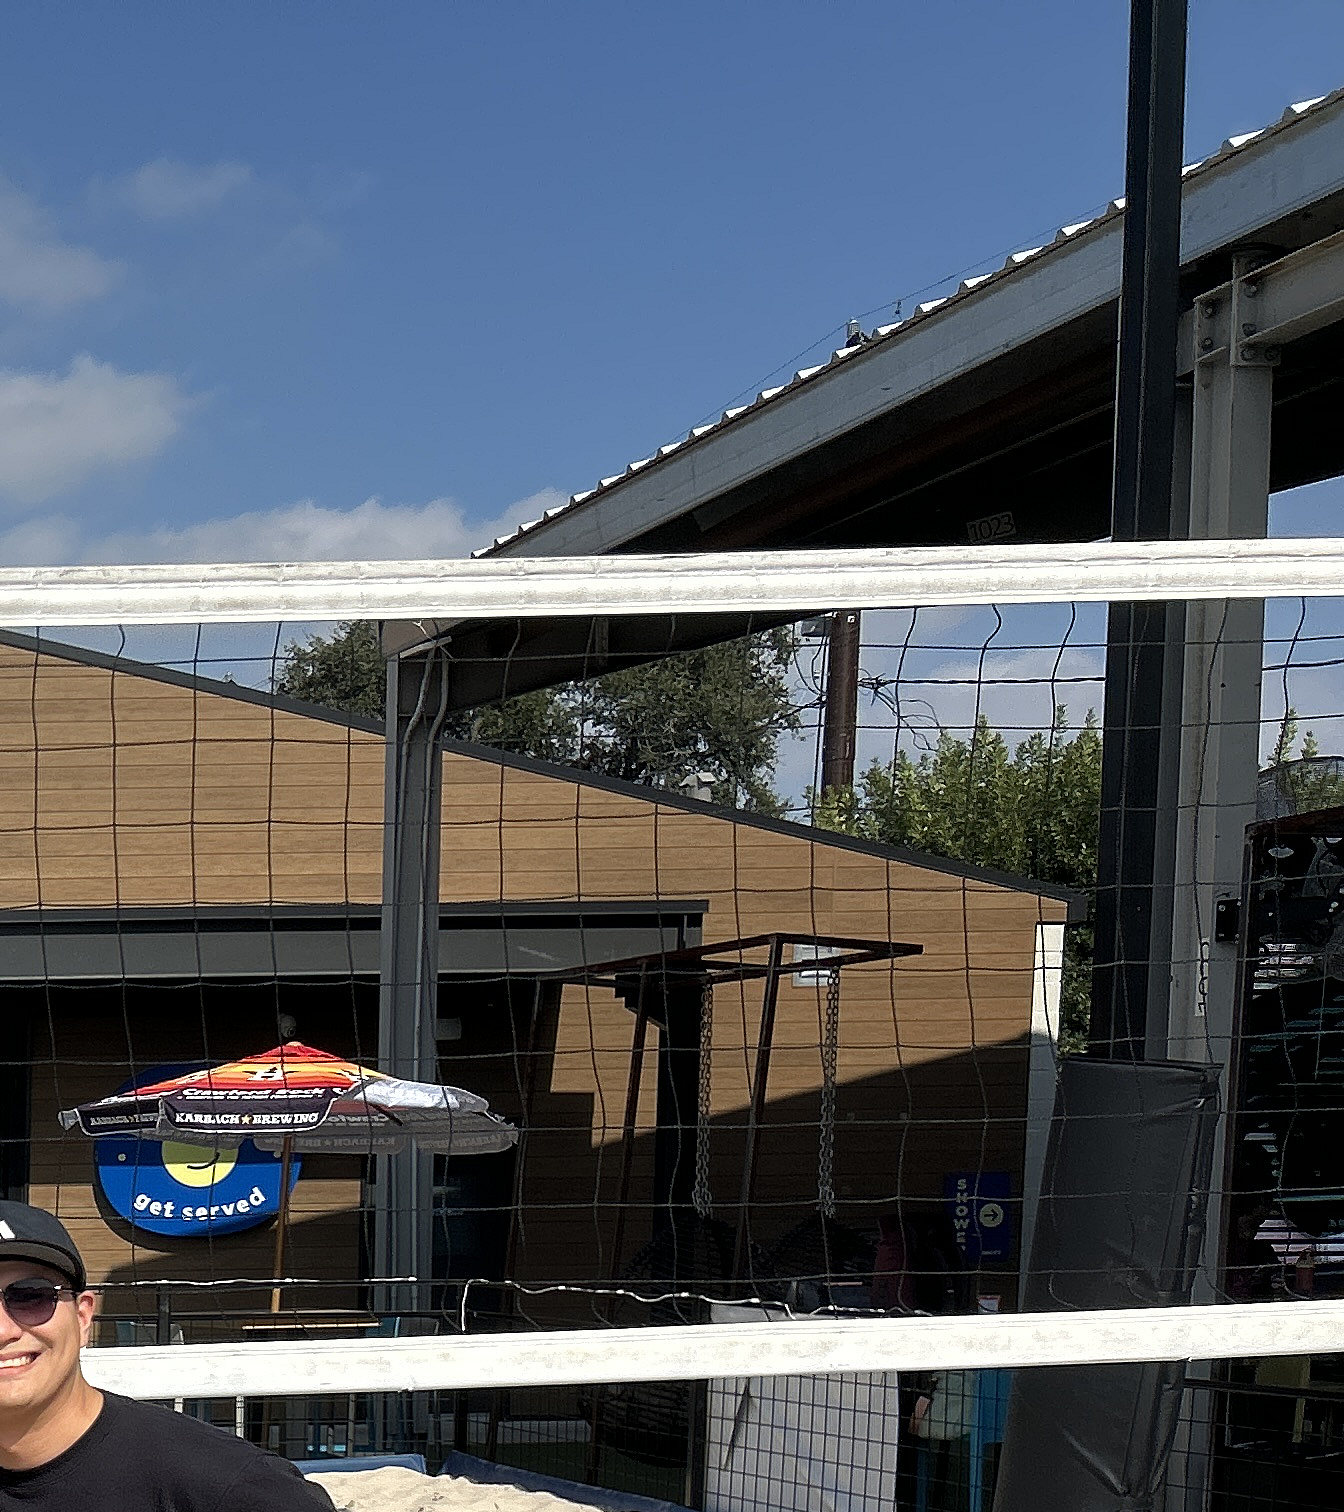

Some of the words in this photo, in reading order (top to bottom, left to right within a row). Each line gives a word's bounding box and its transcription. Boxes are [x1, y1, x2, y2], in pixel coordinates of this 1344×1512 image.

[968, 514, 1014, 540] 1023
[175, 1112, 240, 1124] KARBACH
[252, 1112, 319, 1123] BREWING
[133, 1193, 175, 1218] get
[182, 1186, 266, 1221] served
